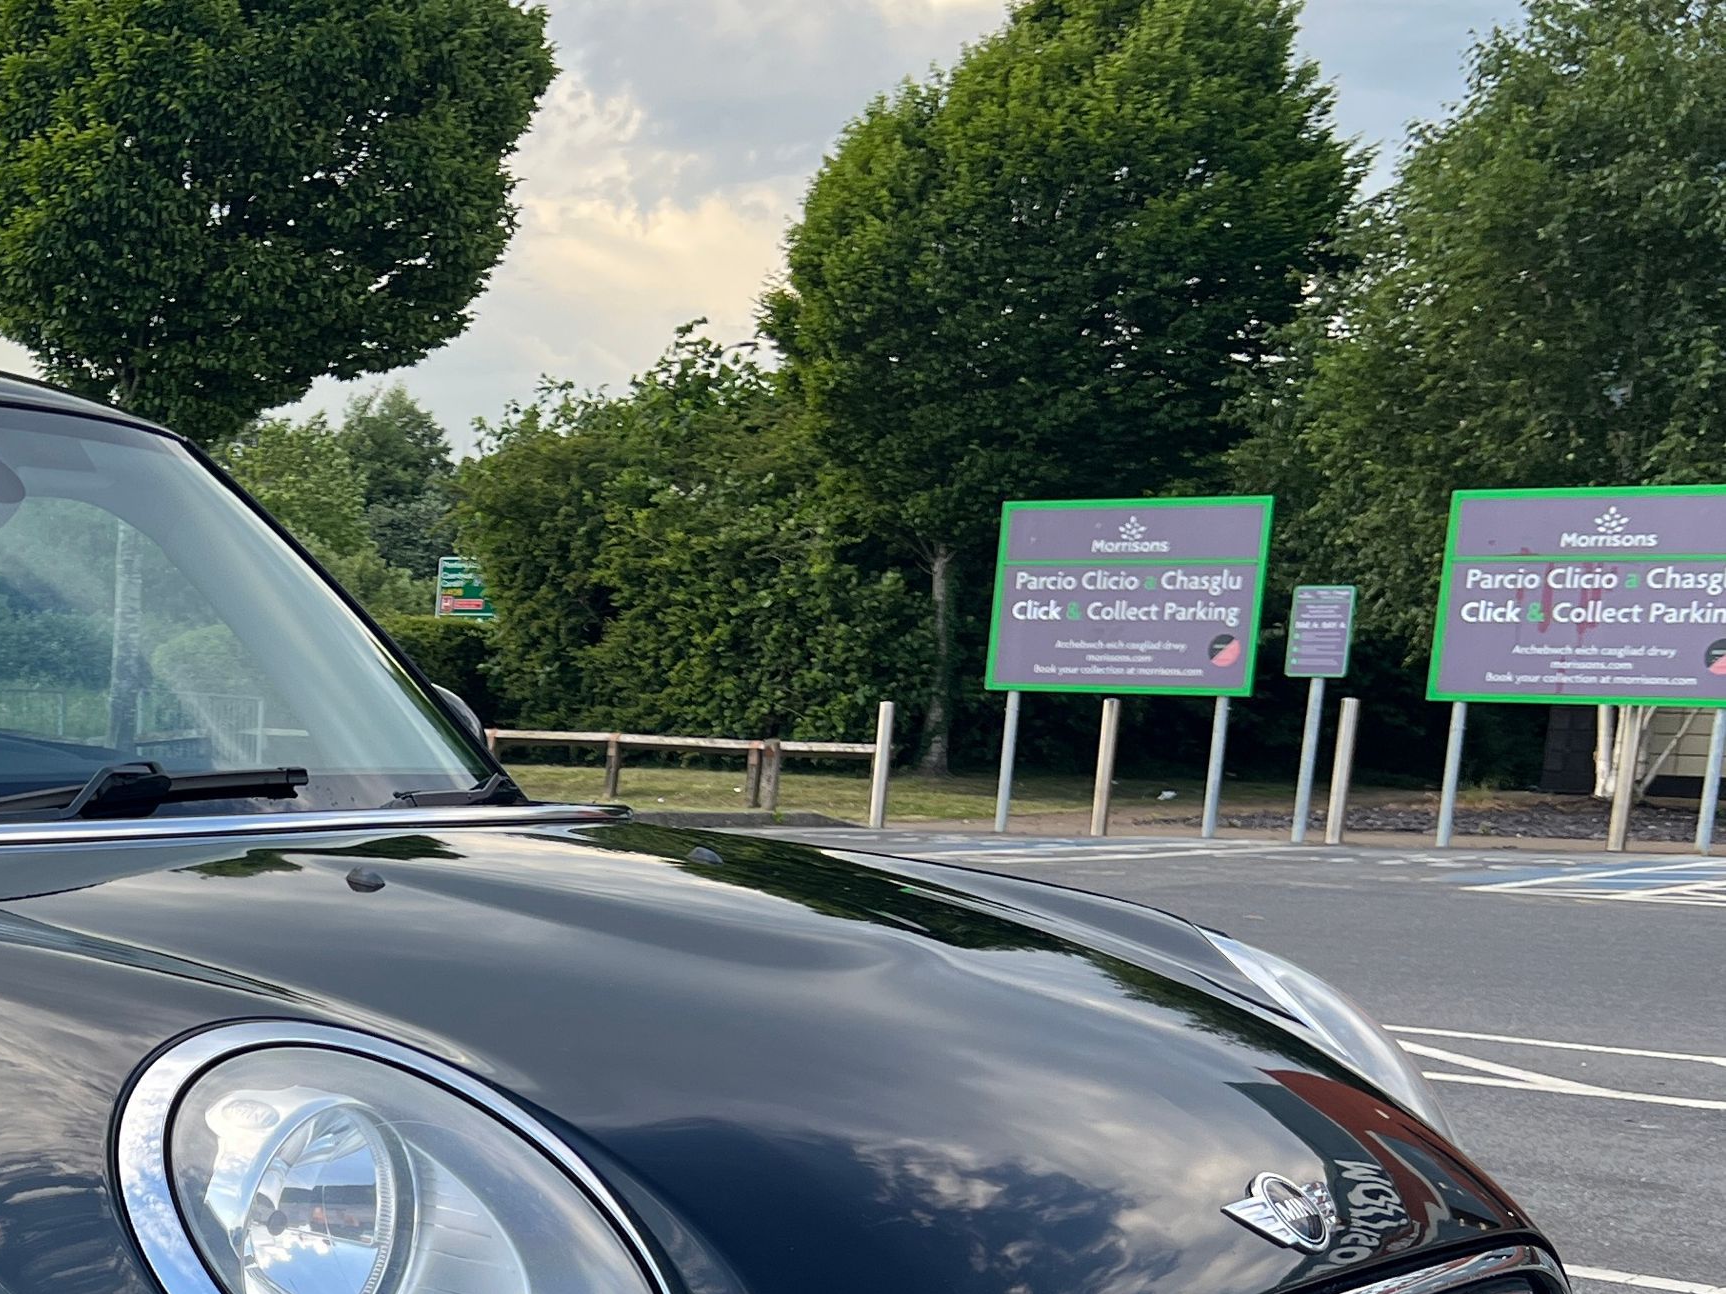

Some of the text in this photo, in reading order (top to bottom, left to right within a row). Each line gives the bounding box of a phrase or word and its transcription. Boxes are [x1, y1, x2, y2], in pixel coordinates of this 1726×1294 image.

[1091, 539, 1171, 553] Morrisons
[1560, 532, 1658, 548] Morrisons
[1015, 569, 1243, 596] Parcio Clicio a Chasglu
[1465, 568, 1541, 590] Parcio
[1547, 567, 1618, 589] Clicio
[1625, 573, 1641, 589] a
[1011, 599, 1241, 627] Click & Collect Parking
[1460, 600, 1522, 623] Click
[1526, 602, 1544, 623] &
[1552, 600, 1643, 624] Collect
[1485, 672, 1513, 683] Book
[1514, 673, 1541, 685] your
[1543, 672, 1598, 685] collection
